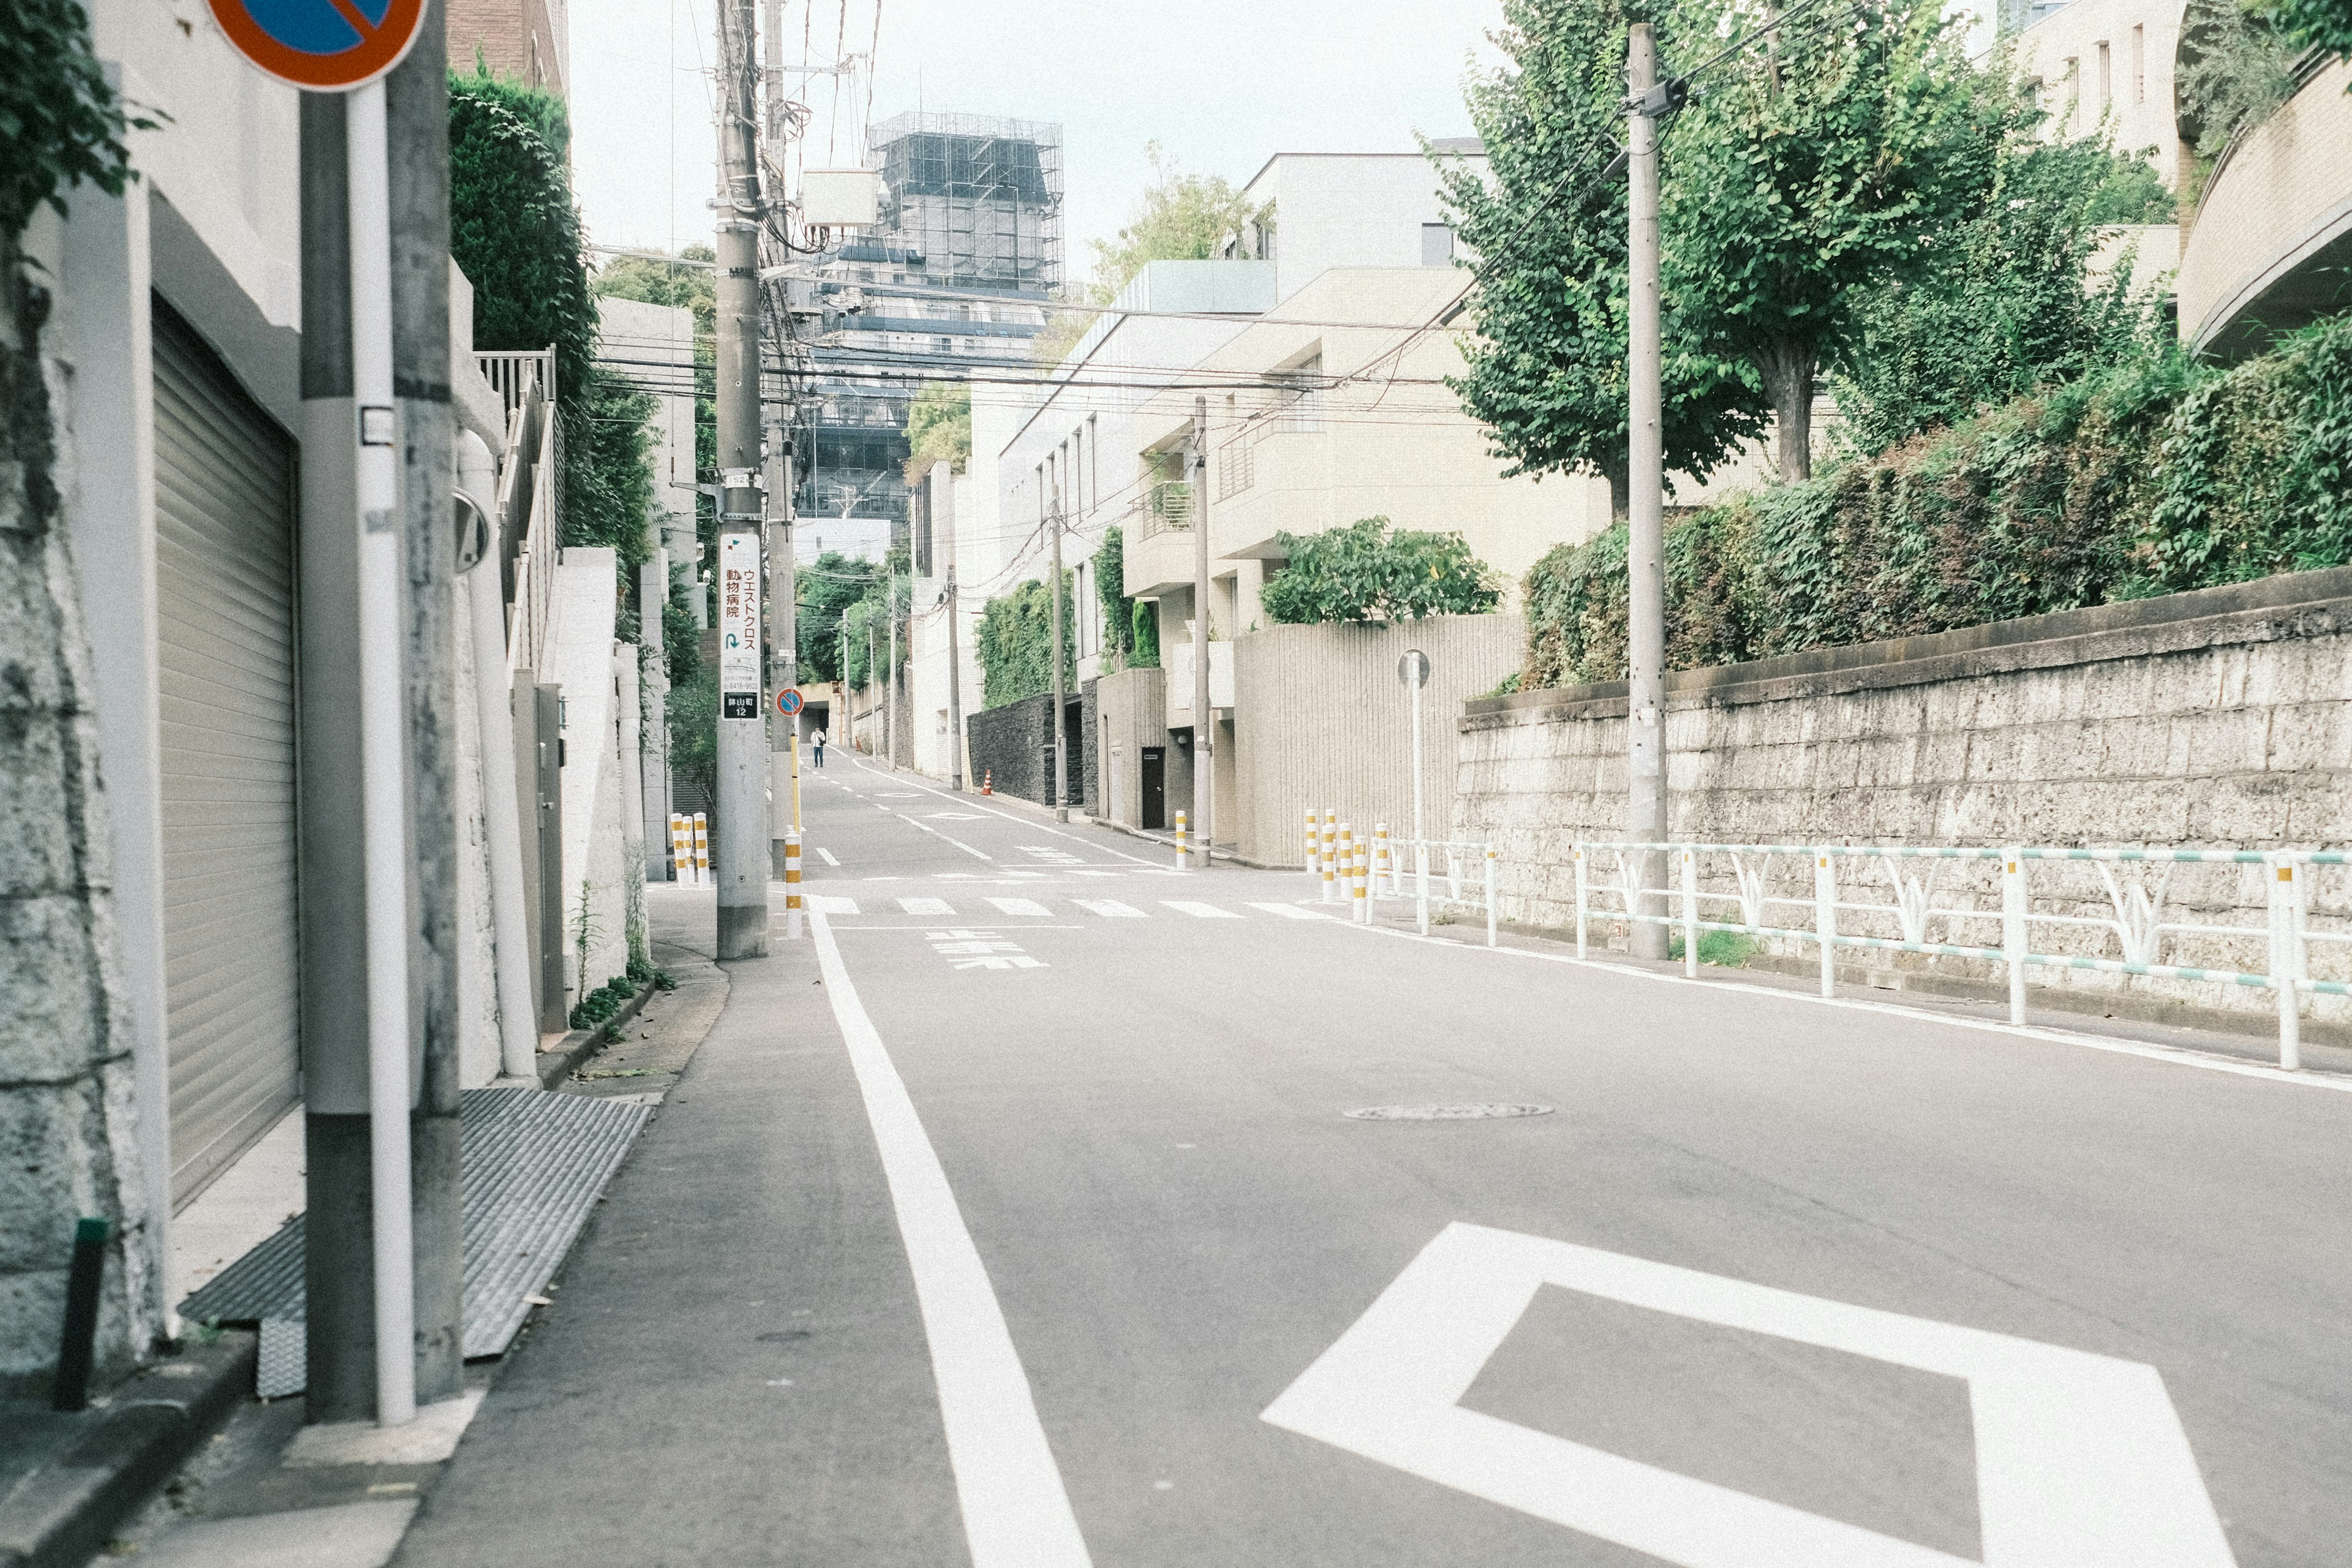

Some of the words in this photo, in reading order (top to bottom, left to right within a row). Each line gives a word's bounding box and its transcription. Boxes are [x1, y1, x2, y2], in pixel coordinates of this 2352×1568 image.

[726, 570, 739, 617] 動物病院
[744, 570, 755, 650] ウエストクロス
[728, 698, 753, 706] 鉢山町
[924, 930, 1051, 970] 止まれ
